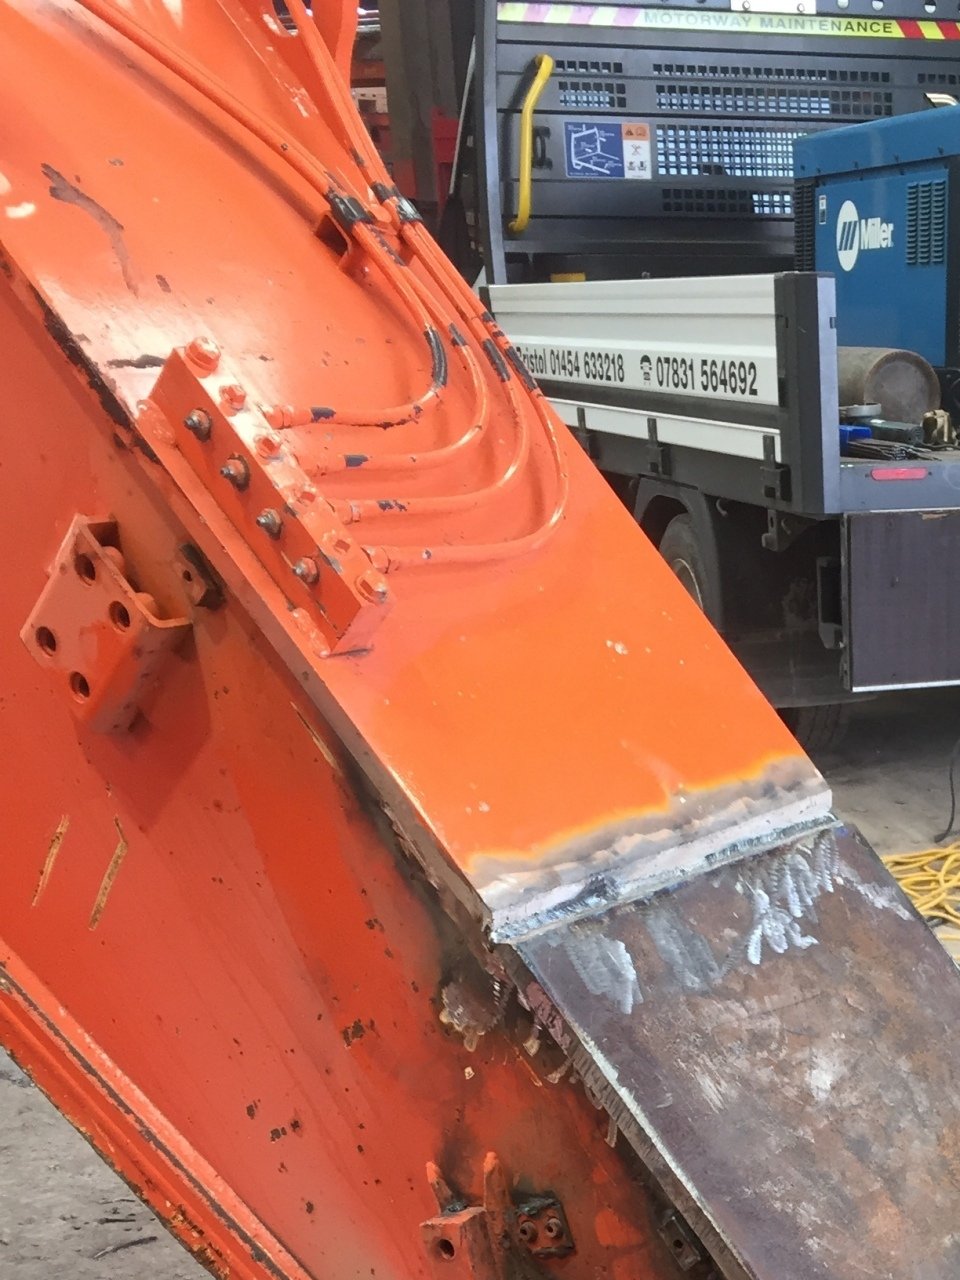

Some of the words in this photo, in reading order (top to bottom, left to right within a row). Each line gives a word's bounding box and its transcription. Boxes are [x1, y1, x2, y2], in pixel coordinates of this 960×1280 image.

[643, 10, 751, 26] MOTORWAY
[759, 16, 893, 34] MAINTENANCE
[860, 216, 894, 250] Miller
[549, 349, 580, 378] 01454
[583, 351, 625, 383] 633218
[656, 356, 695, 390] 07831
[700, 359, 758, 396] 564692
